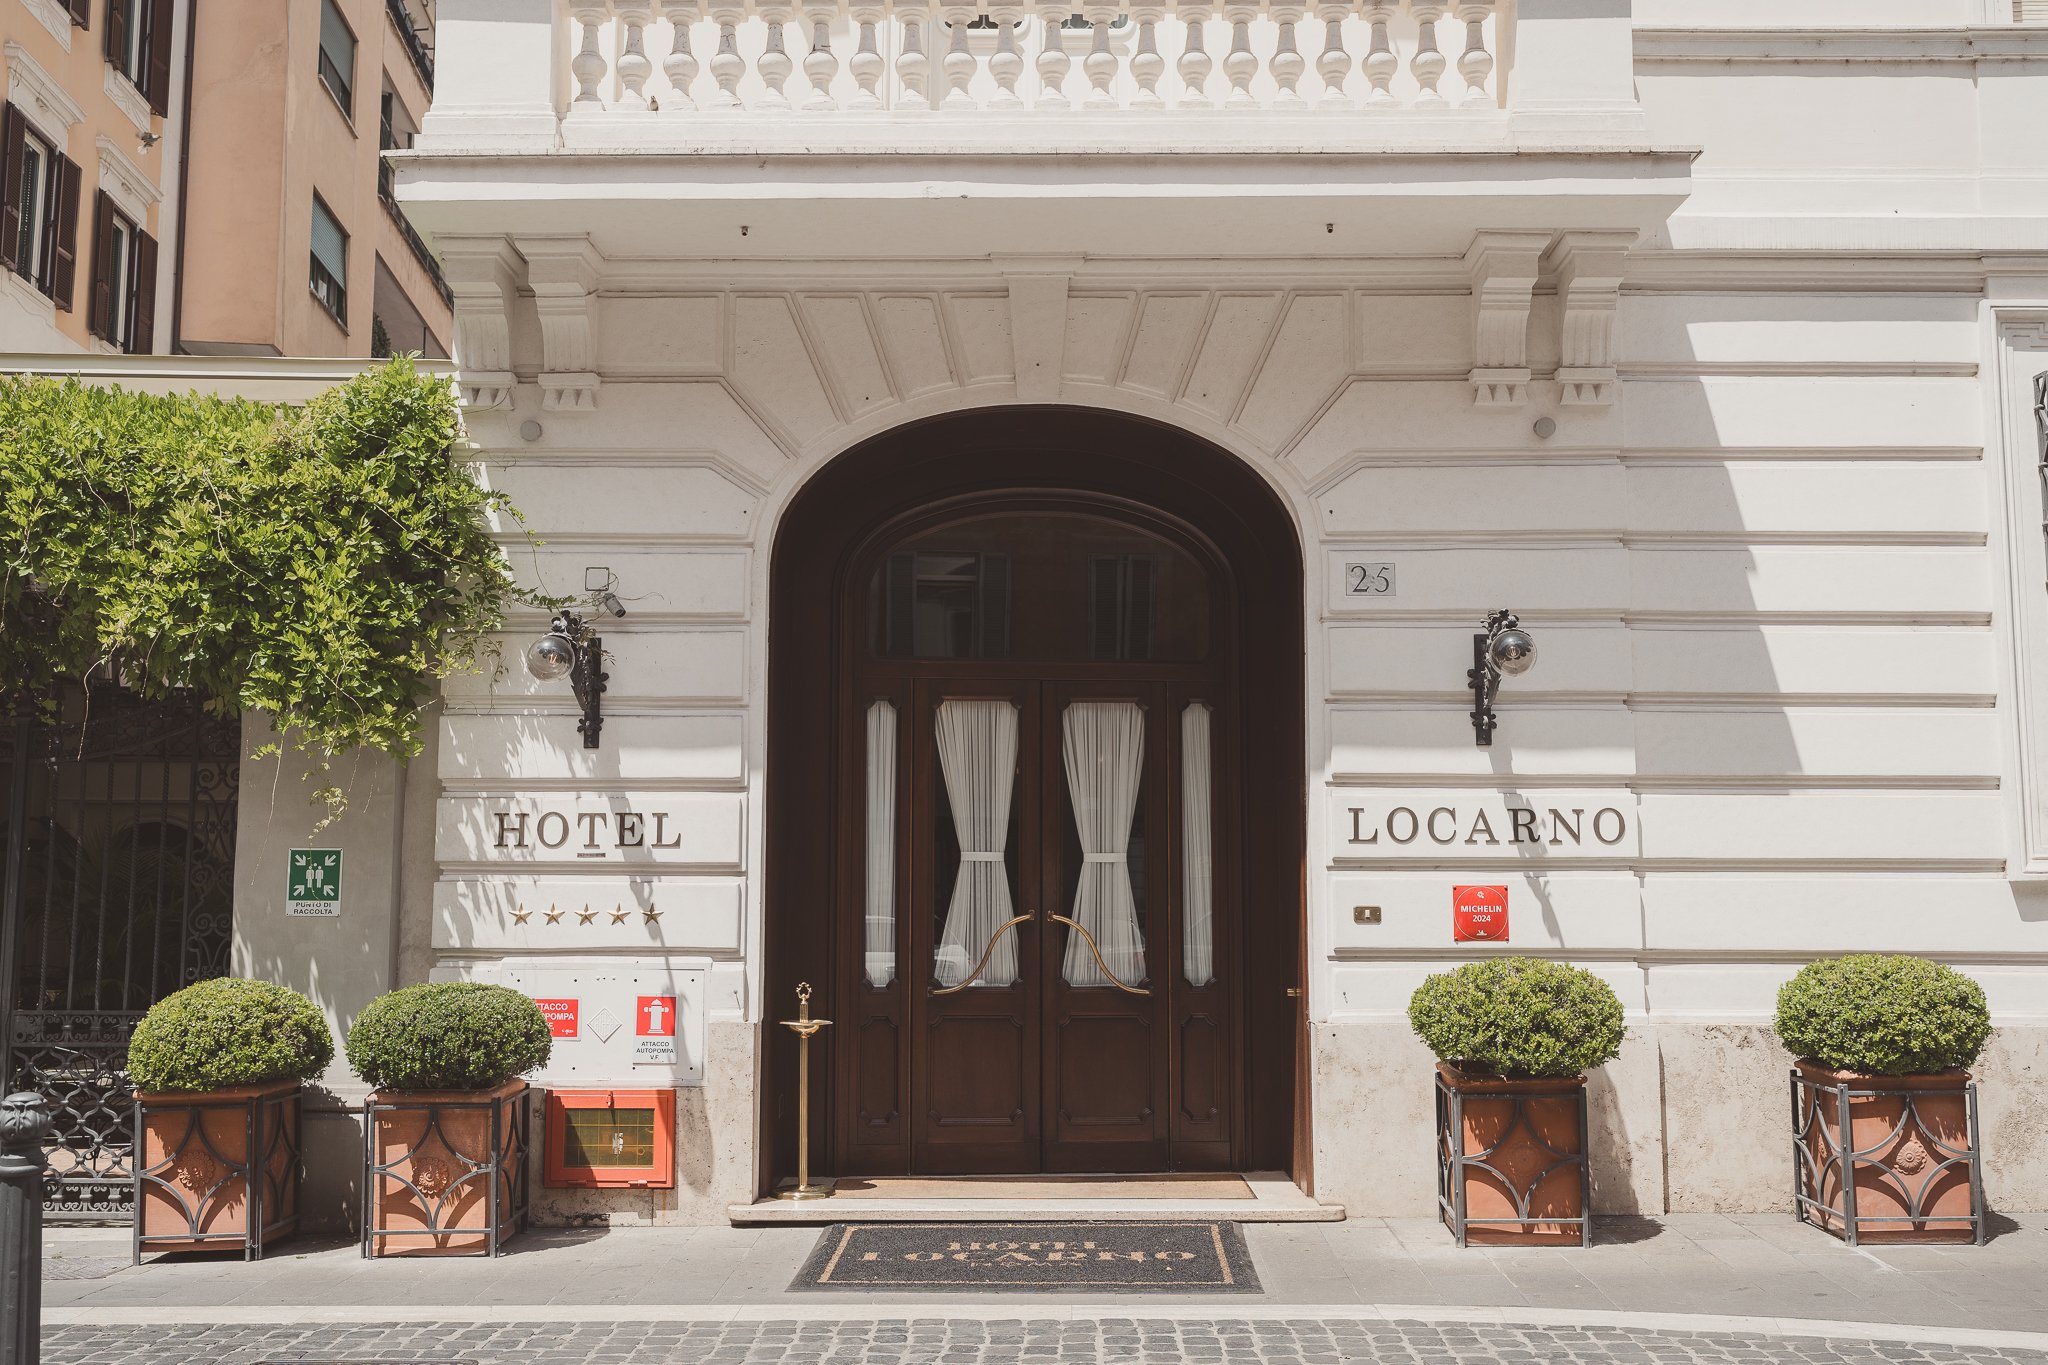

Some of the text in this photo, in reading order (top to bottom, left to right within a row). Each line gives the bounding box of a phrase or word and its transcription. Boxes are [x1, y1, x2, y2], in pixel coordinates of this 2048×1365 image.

[1351, 565, 1389, 592] 25
[494, 807, 1626, 849] HOTEL LOCARNO
[1472, 914, 1491, 922] 2024
[858, 1251, 1198, 1262] LOCARNO
